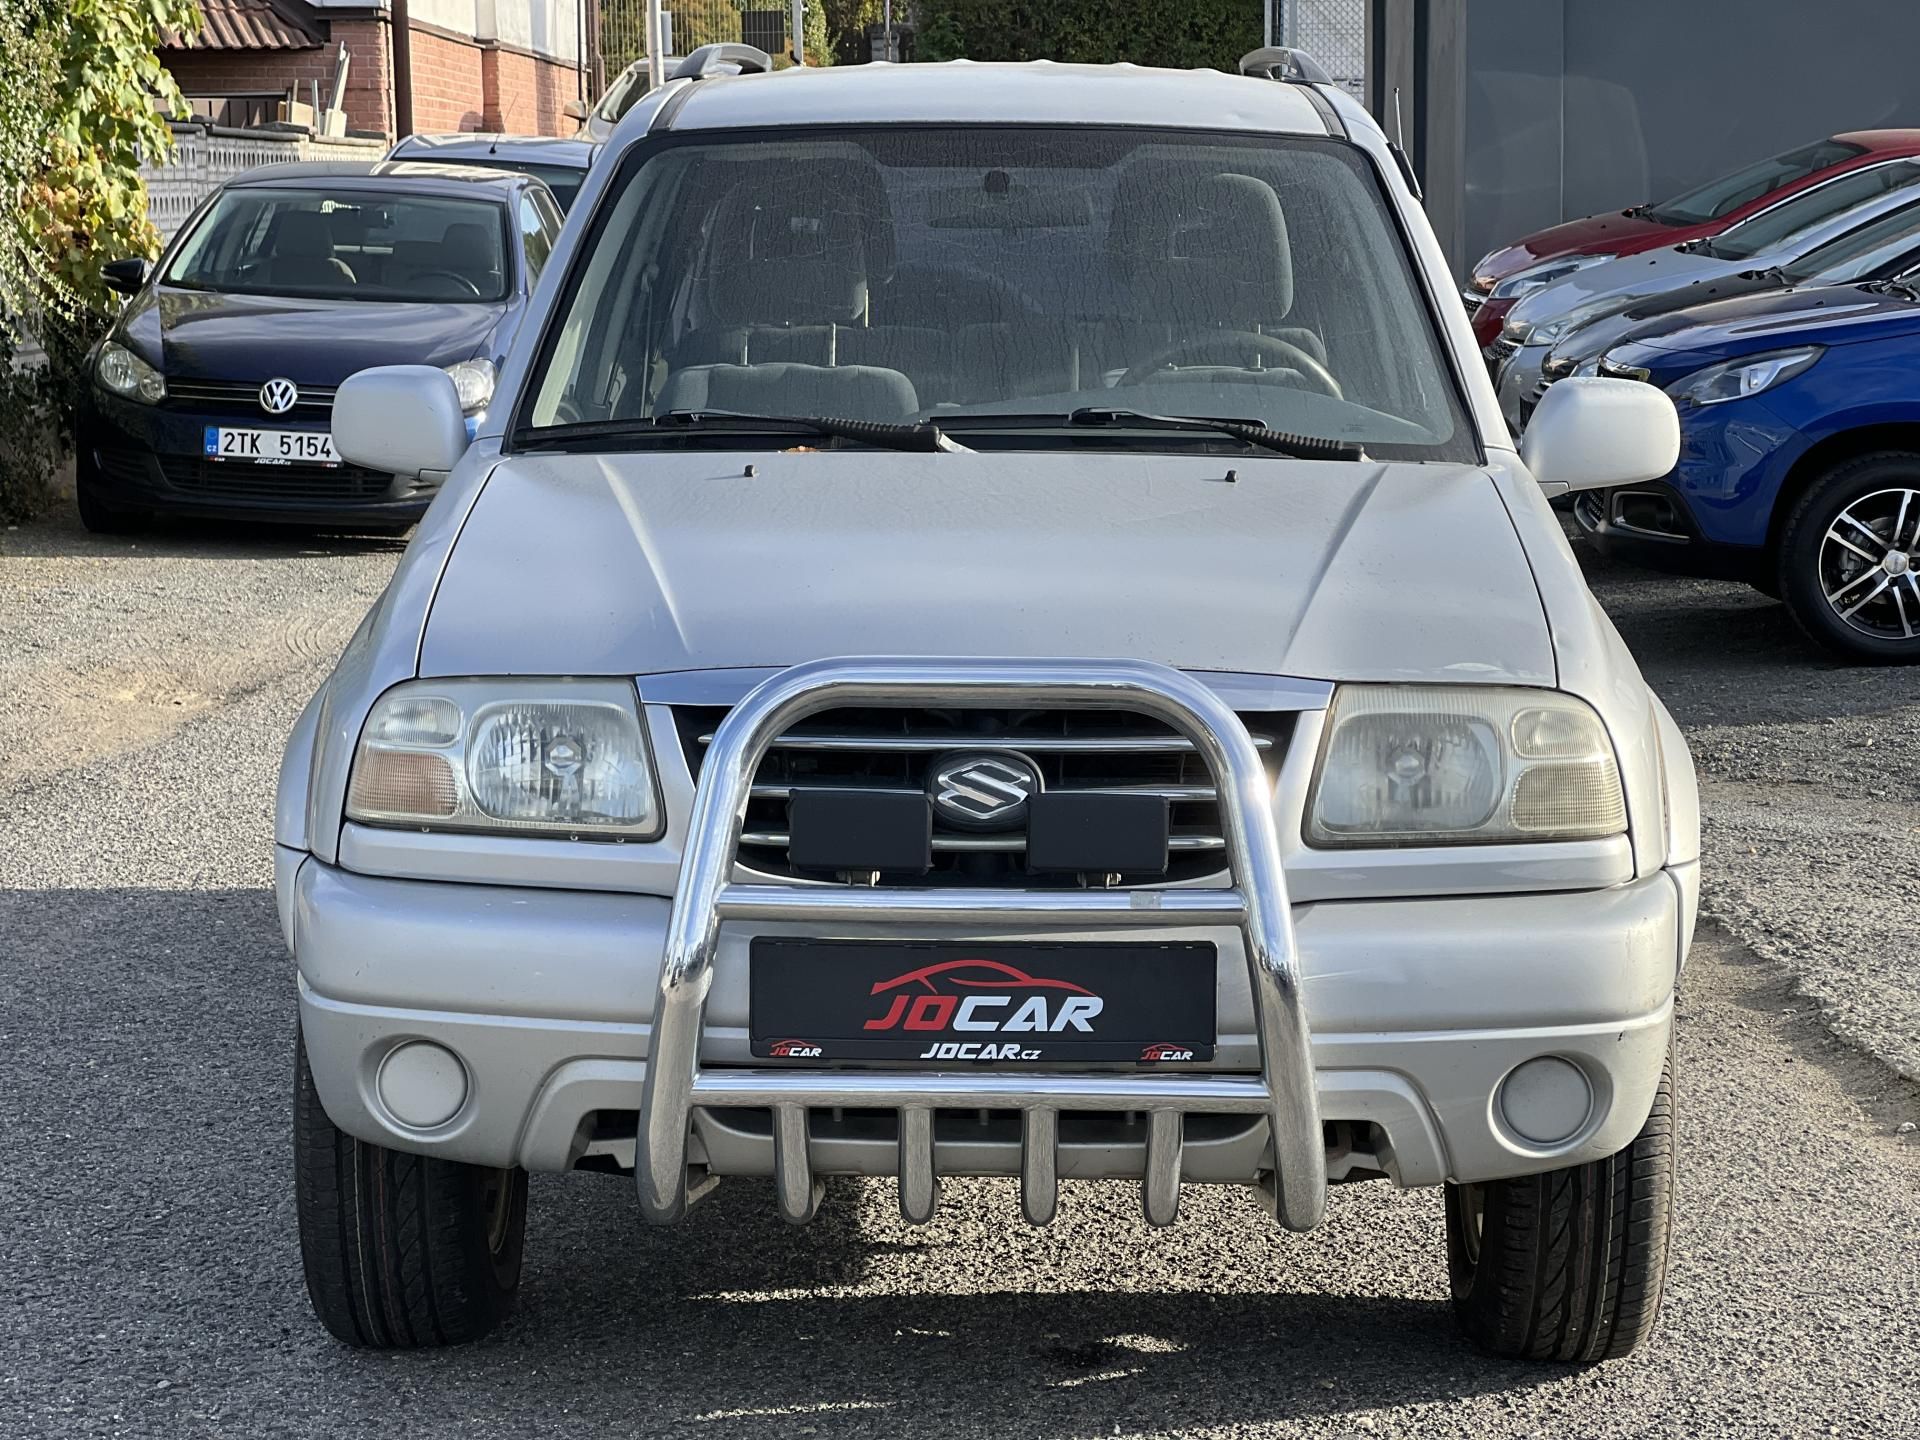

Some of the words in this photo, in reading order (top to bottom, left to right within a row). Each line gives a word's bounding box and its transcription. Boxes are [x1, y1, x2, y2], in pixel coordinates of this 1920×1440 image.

[223, 432, 262, 454] 2TK
[280, 435, 332, 458] 5154
[254, 458, 291, 466] JOCAR
[863, 995, 1104, 1032] JOCAR
[769, 1046, 823, 1057] JOCAR
[920, 1043, 1042, 1060] JOCAR.cz
[1141, 1050, 1193, 1060] JOCAR
